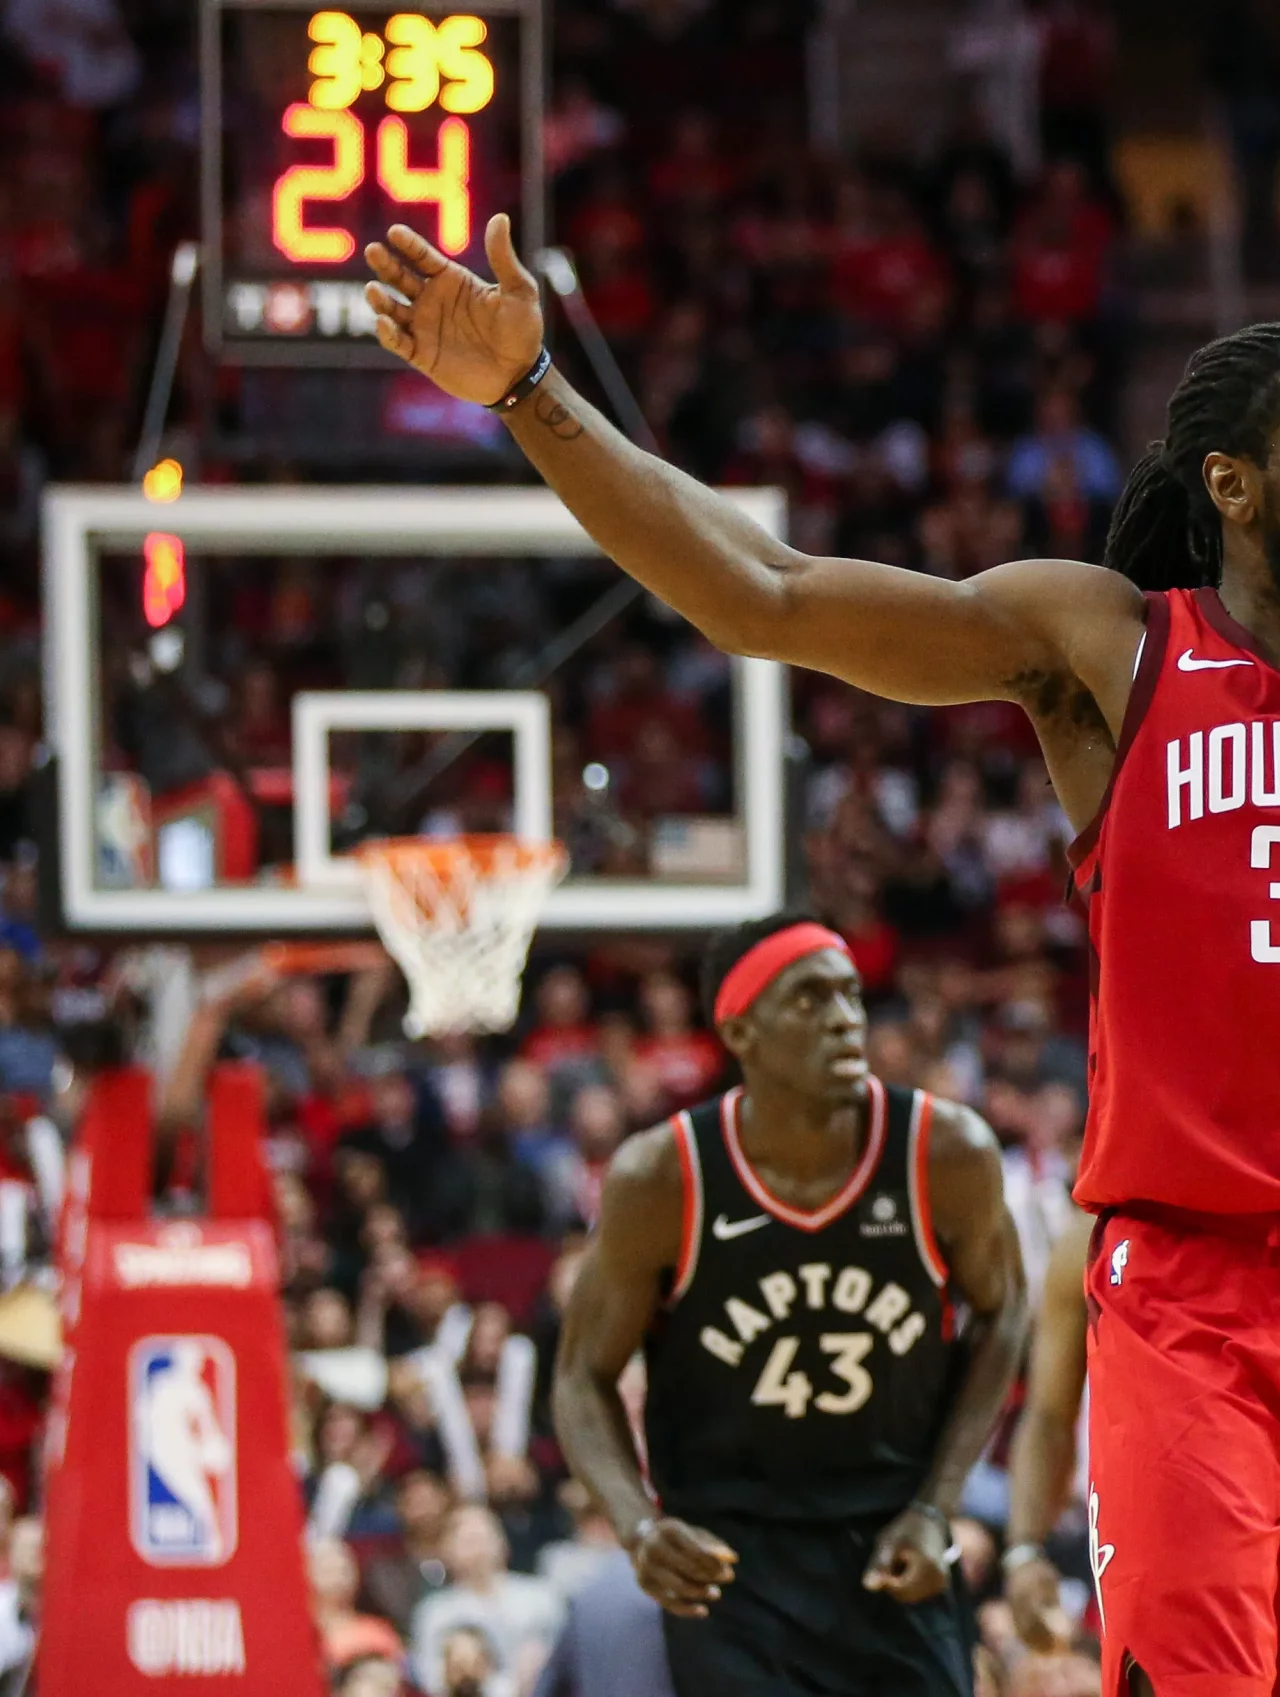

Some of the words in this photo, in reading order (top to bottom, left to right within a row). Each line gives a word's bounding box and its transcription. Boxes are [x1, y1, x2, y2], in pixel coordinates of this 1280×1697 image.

[308, 11, 494, 113] 3:35
[273, 103, 470, 262] 24
[700, 1262, 926, 1368] RAPTORS
[751, 1332, 874, 1418] 43
